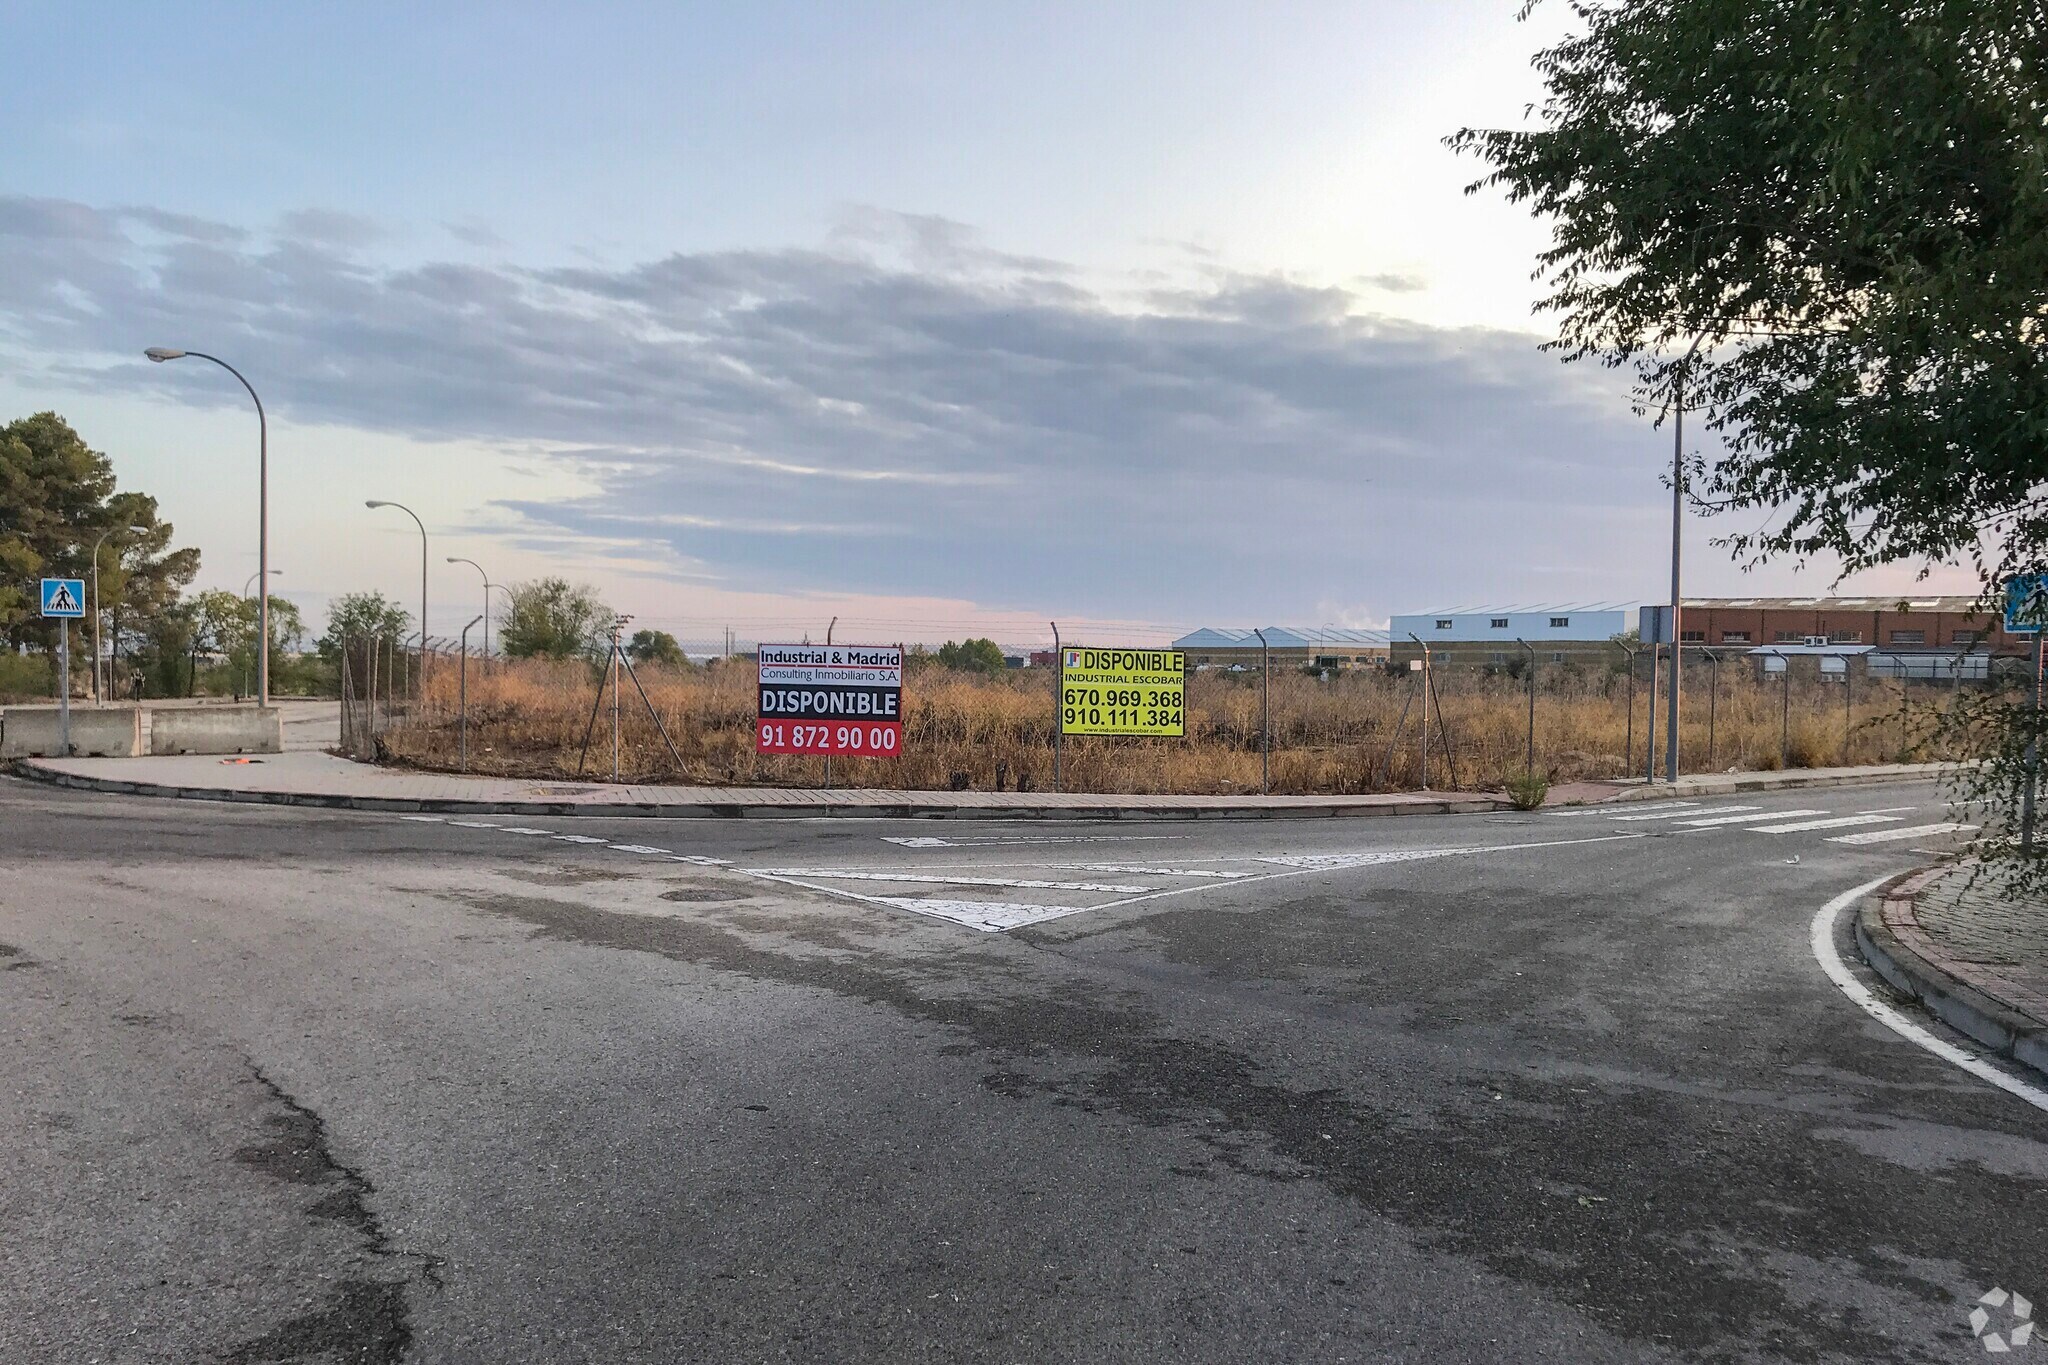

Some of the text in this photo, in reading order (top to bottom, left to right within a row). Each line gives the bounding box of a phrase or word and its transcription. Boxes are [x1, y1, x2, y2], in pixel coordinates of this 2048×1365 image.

[761, 650, 900, 666] Industrial & Madrid
[1084, 651, 1183, 672] DISPONIBLE
[761, 668, 899, 681] Consulting Inmobiliario S.A.
[1065, 673, 1183, 685] INDUSTRIAL ESCOBAR
[762, 690, 897, 715] DISPONIBLE
[1064, 688, 1182, 707] 670.969.368
[1064, 708, 1182, 726] 910.111.384
[762, 724, 896, 750] 91 872 90 00
